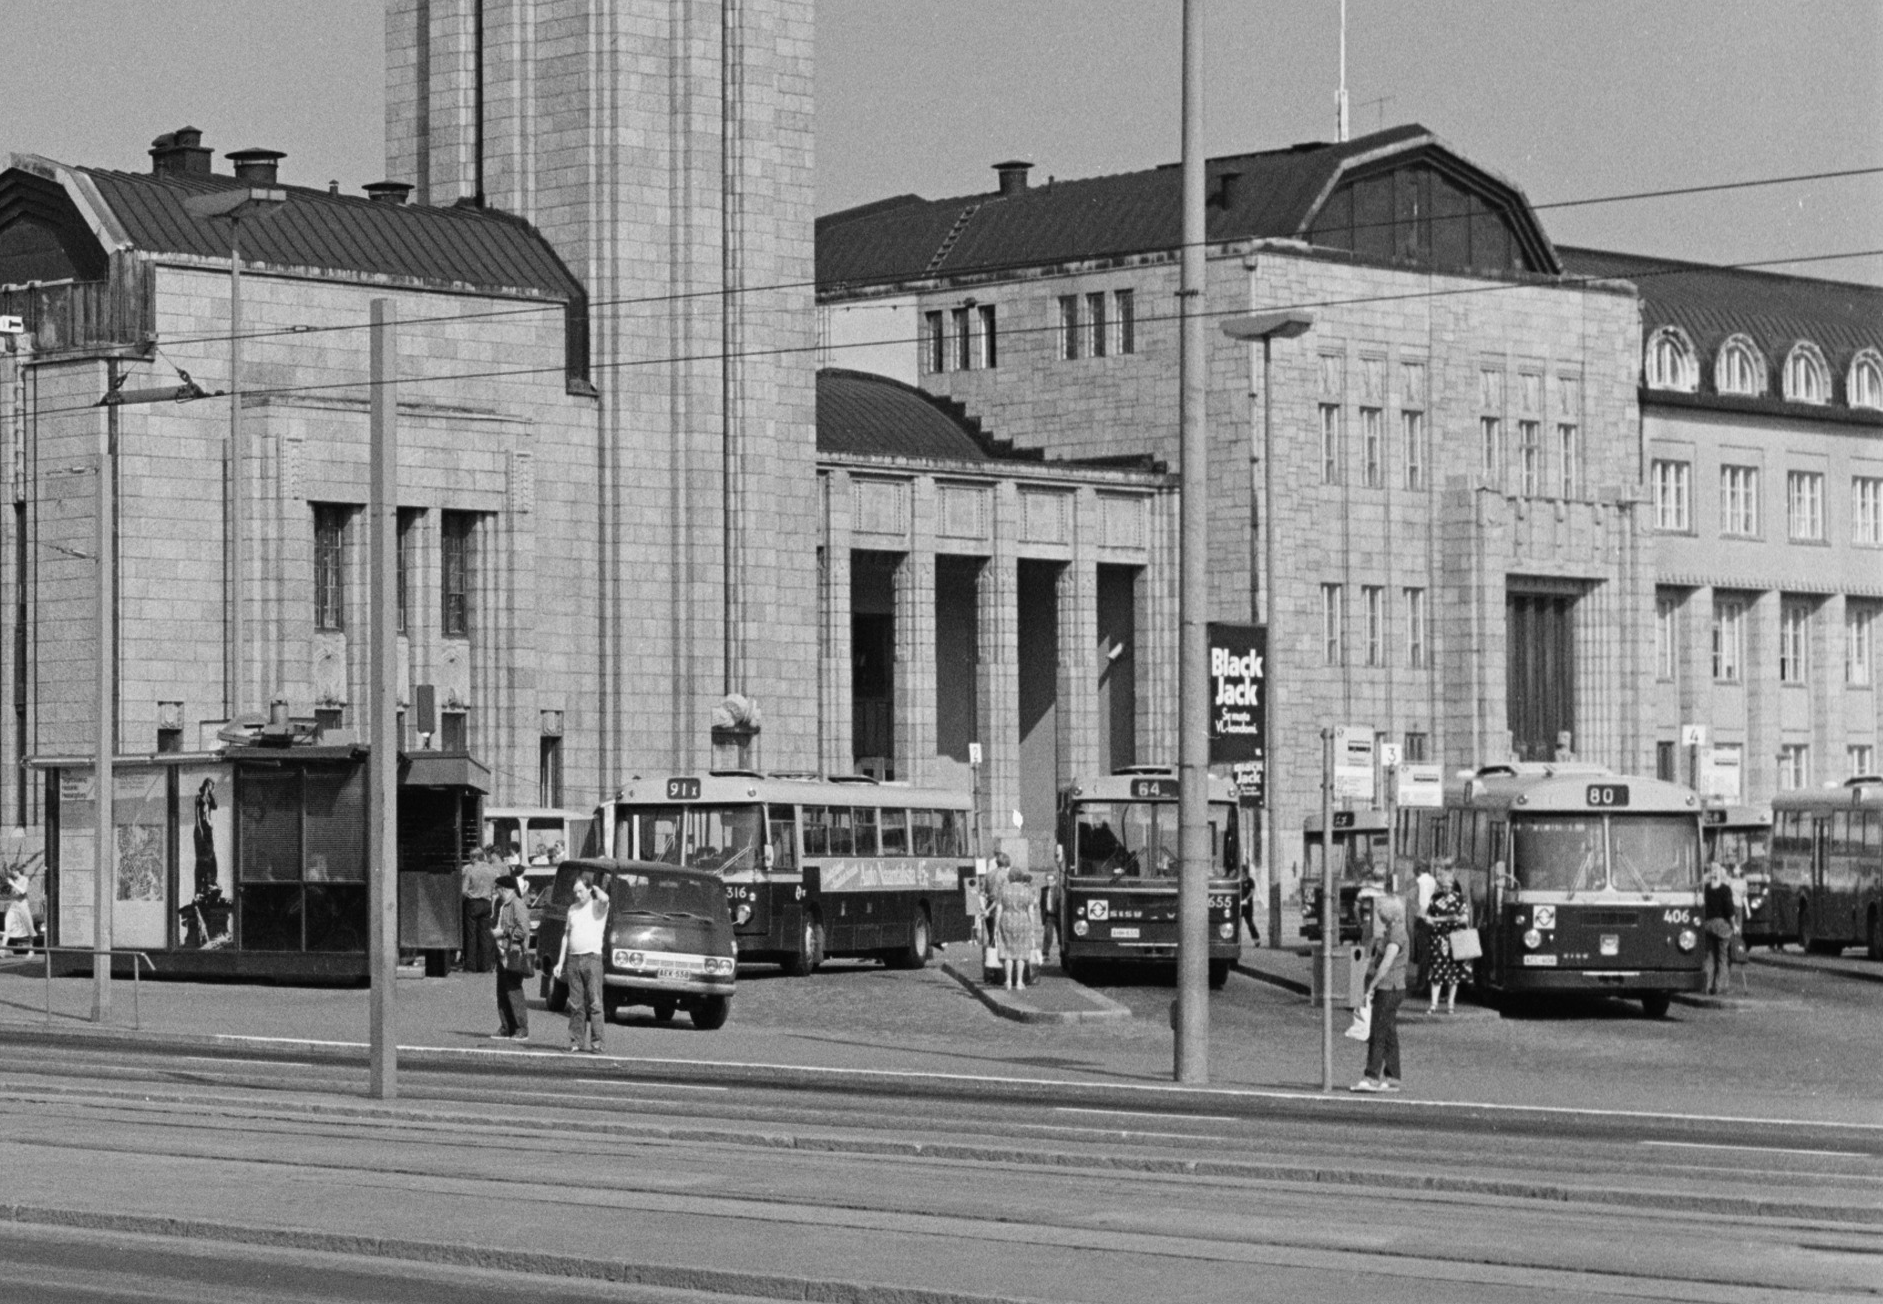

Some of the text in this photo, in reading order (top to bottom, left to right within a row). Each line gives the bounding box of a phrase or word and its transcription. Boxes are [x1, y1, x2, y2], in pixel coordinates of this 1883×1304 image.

[1211, 647, 1263, 677] Black
[1215, 676, 1258, 705] Jack
[1388, 747, 1396, 762] 3
[1138, 782, 1159, 796] 64
[1590, 788, 1613, 804] 80
[726, 886, 747, 899] 316
[1208, 896, 1232, 908] 655
[1664, 909, 1690, 923] 406
